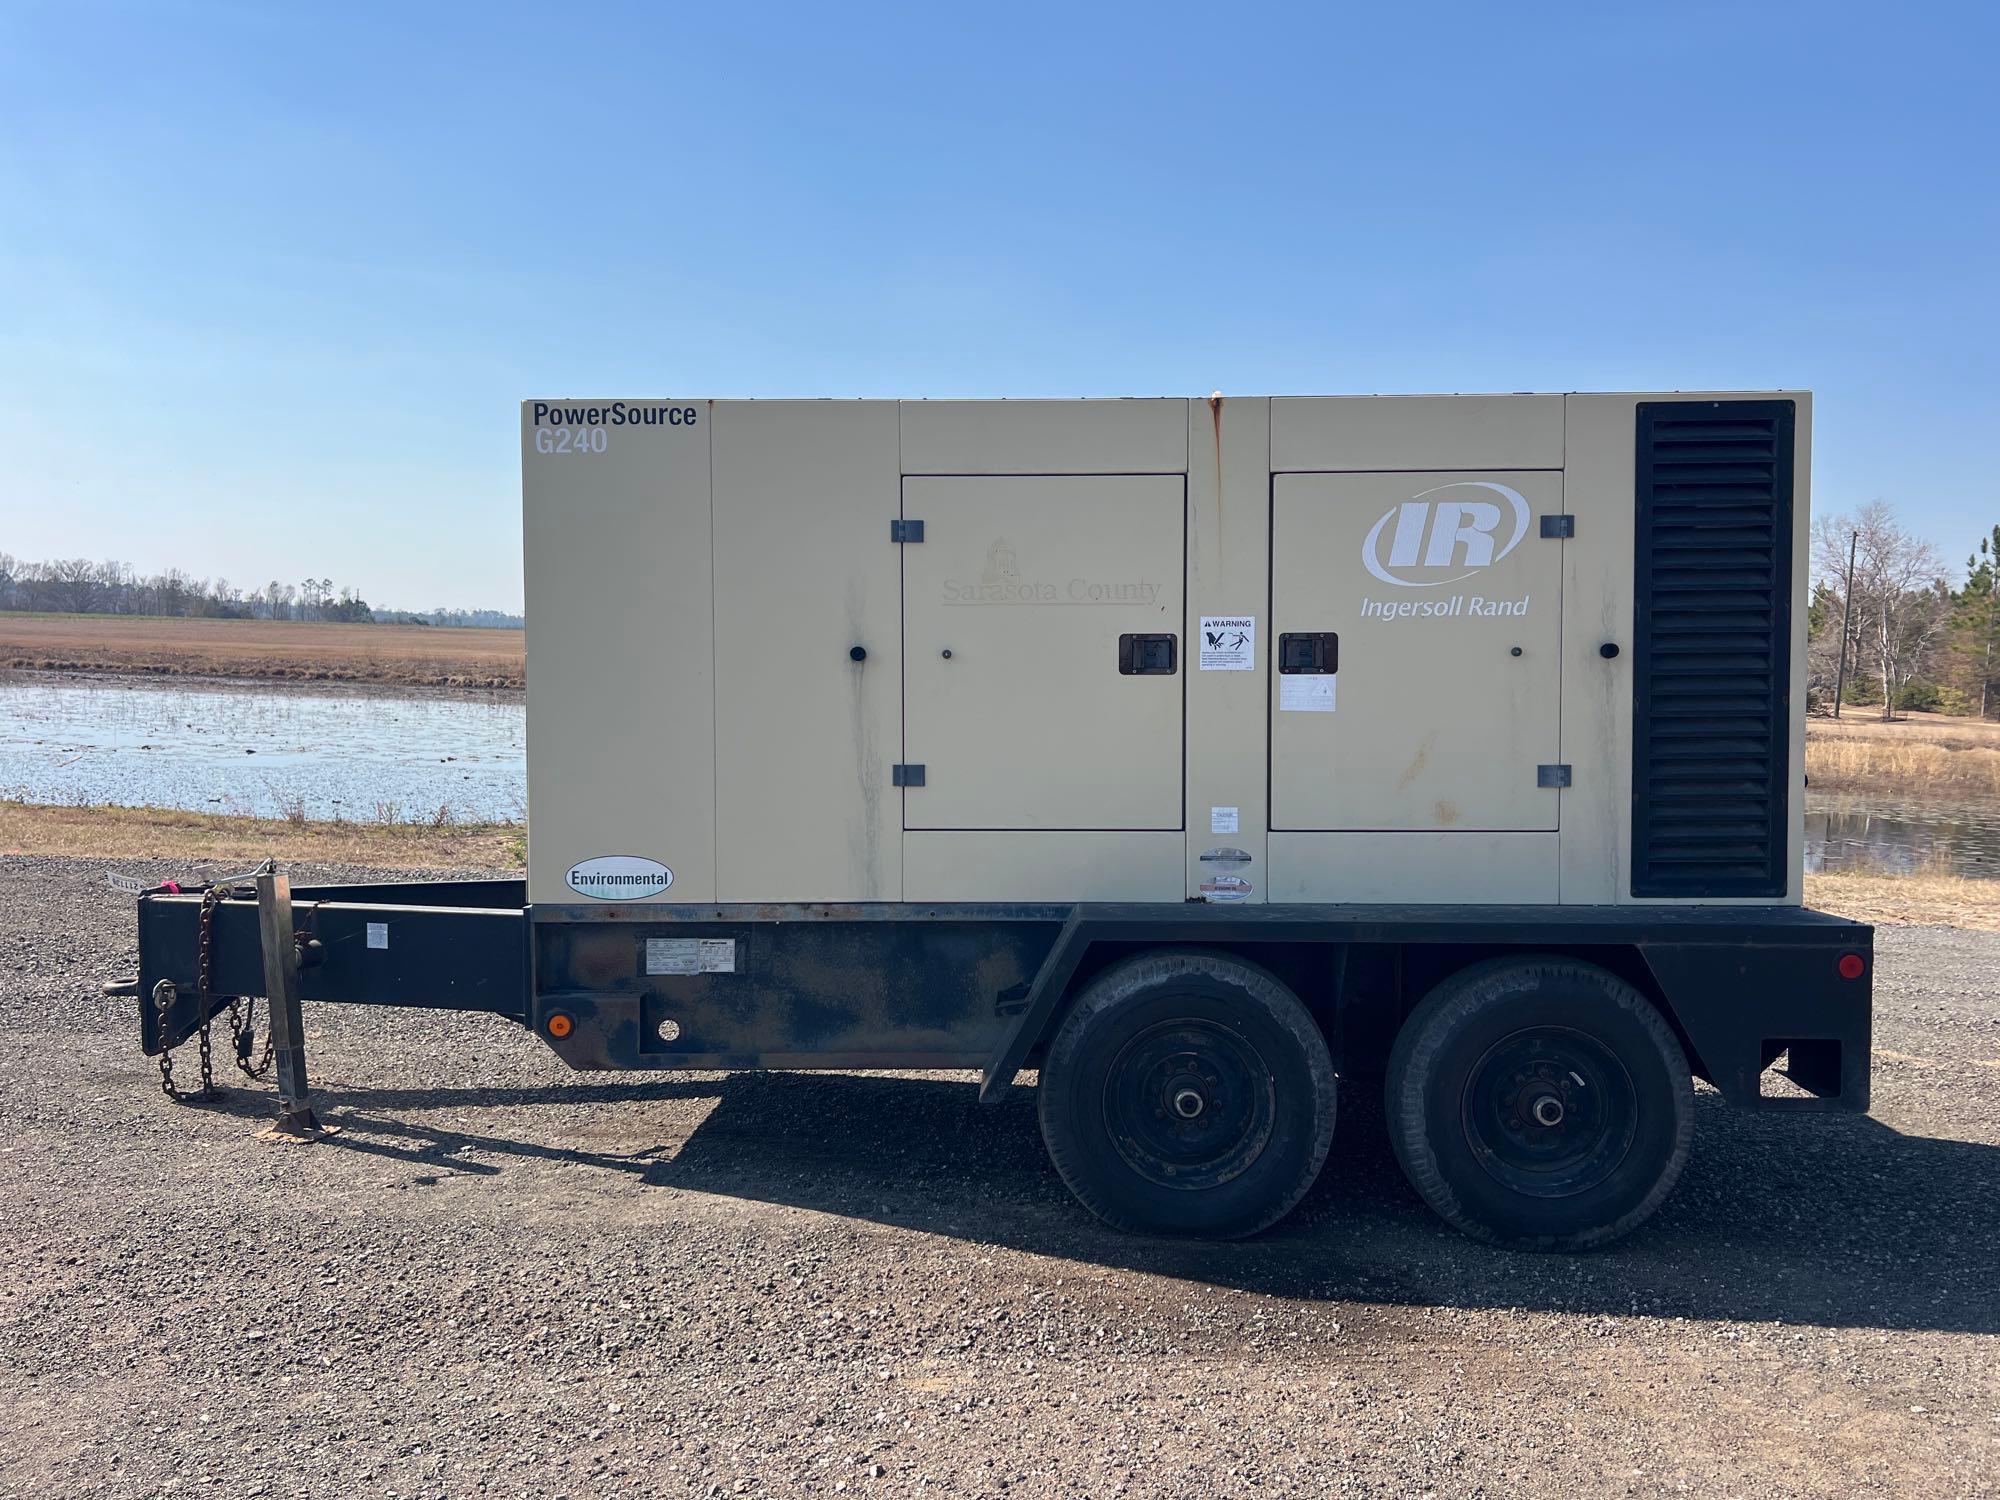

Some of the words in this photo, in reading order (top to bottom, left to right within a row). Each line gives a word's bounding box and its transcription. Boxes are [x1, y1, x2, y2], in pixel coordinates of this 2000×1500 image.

[534, 402, 697, 426] PowerSource
[535, 427, 608, 454] G240
[1388, 502, 1501, 567] IR
[942, 578, 1057, 601] Sarasota
[1067, 577, 1163, 604] County
[1360, 597, 1463, 622] Ingersoll
[1468, 595, 1530, 617] Rand
[1212, 620, 1251, 628] WARNING
[571, 870, 668, 885] Environmental
